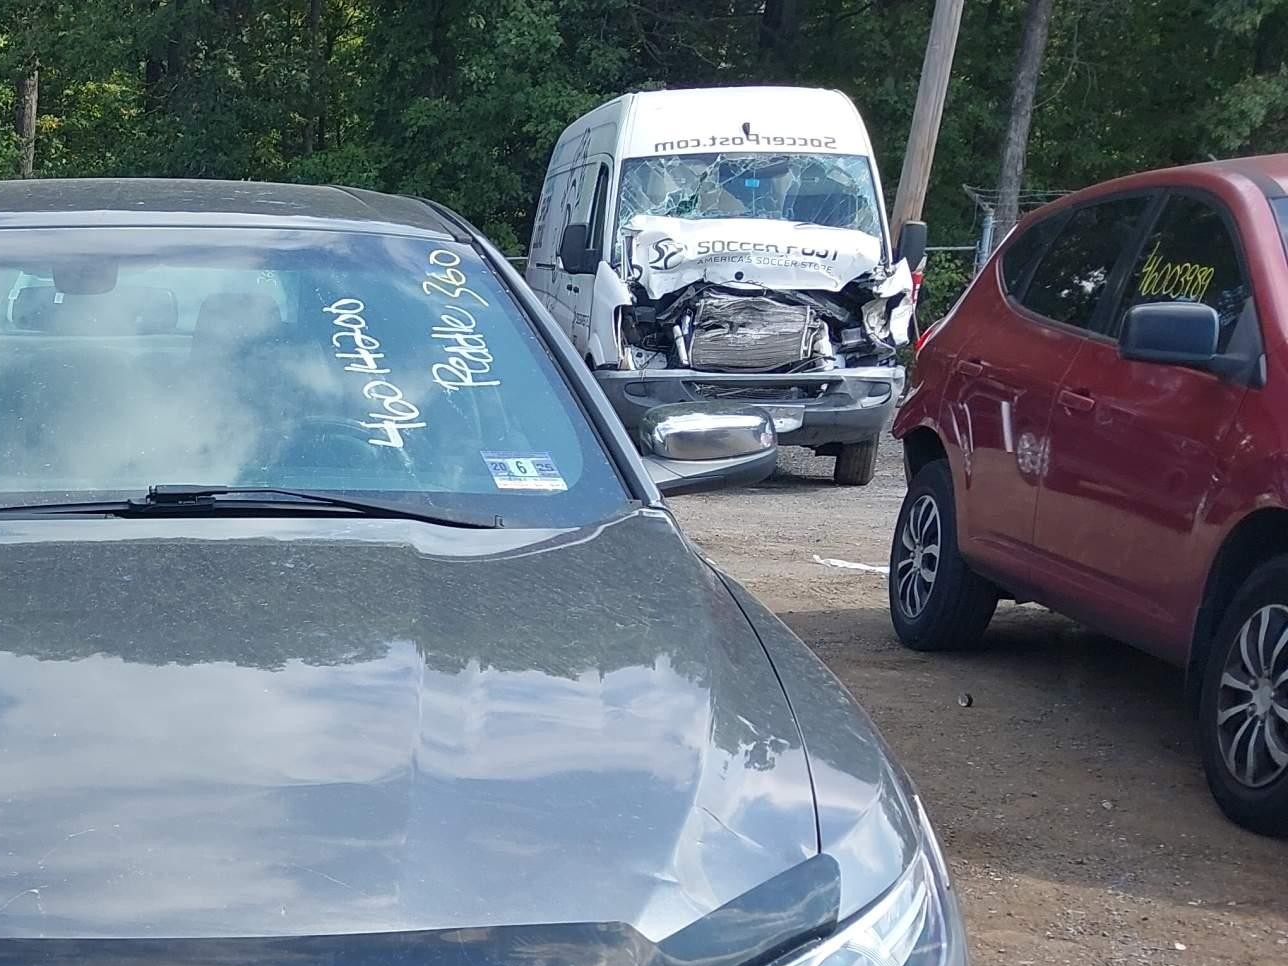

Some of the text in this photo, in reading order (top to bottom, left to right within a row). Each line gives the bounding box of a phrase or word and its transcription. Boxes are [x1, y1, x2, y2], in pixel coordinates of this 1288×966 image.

[697, 254, 753, 265] AMERICA'S
[755, 256, 798, 268] SOCCER
[422, 249, 490, 307] 360
[491, 462, 507, 471] 20
[515, 460, 527, 474] 6
